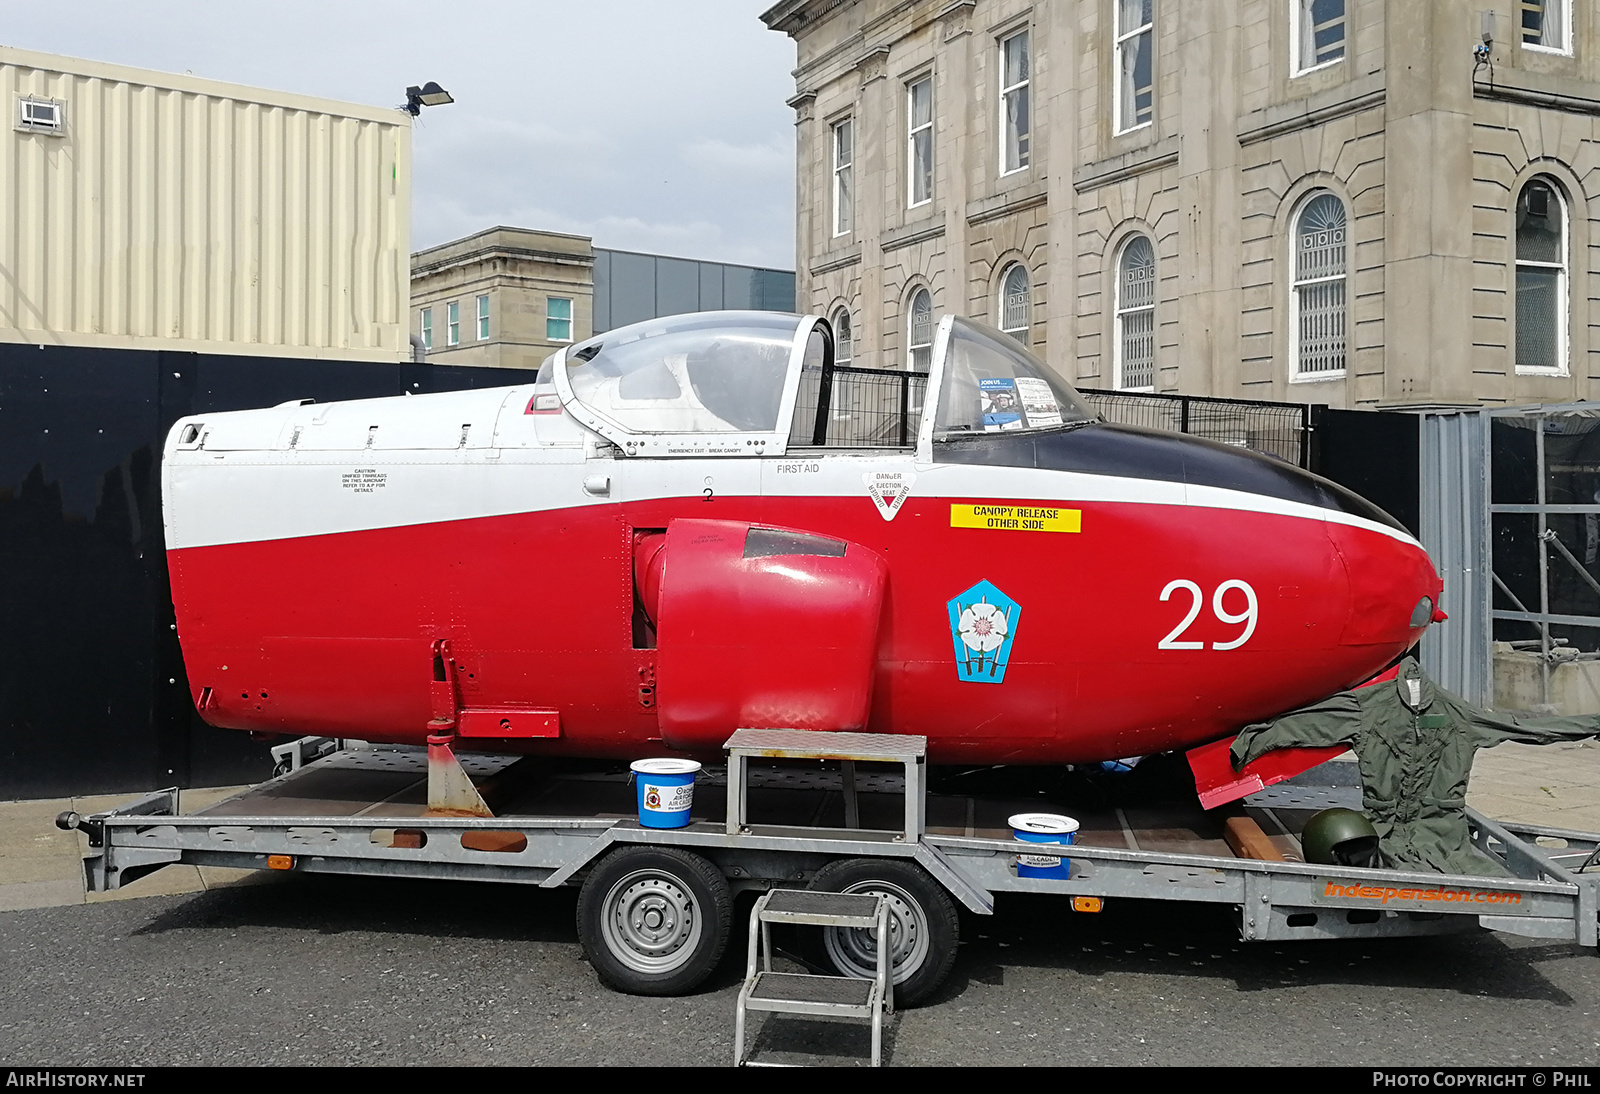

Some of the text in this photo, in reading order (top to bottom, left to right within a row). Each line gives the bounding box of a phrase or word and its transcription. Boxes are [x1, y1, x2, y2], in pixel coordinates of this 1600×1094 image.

[777, 463, 820, 474] FIRST AID
[868, 484, 885, 508] DANGER
[892, 485, 910, 510] DANGER
[973, 506, 1059, 520] CANOPY RELEASE
[987, 518, 1045, 530] OTHER SIDE
[1157, 579, 1259, 651] 29
